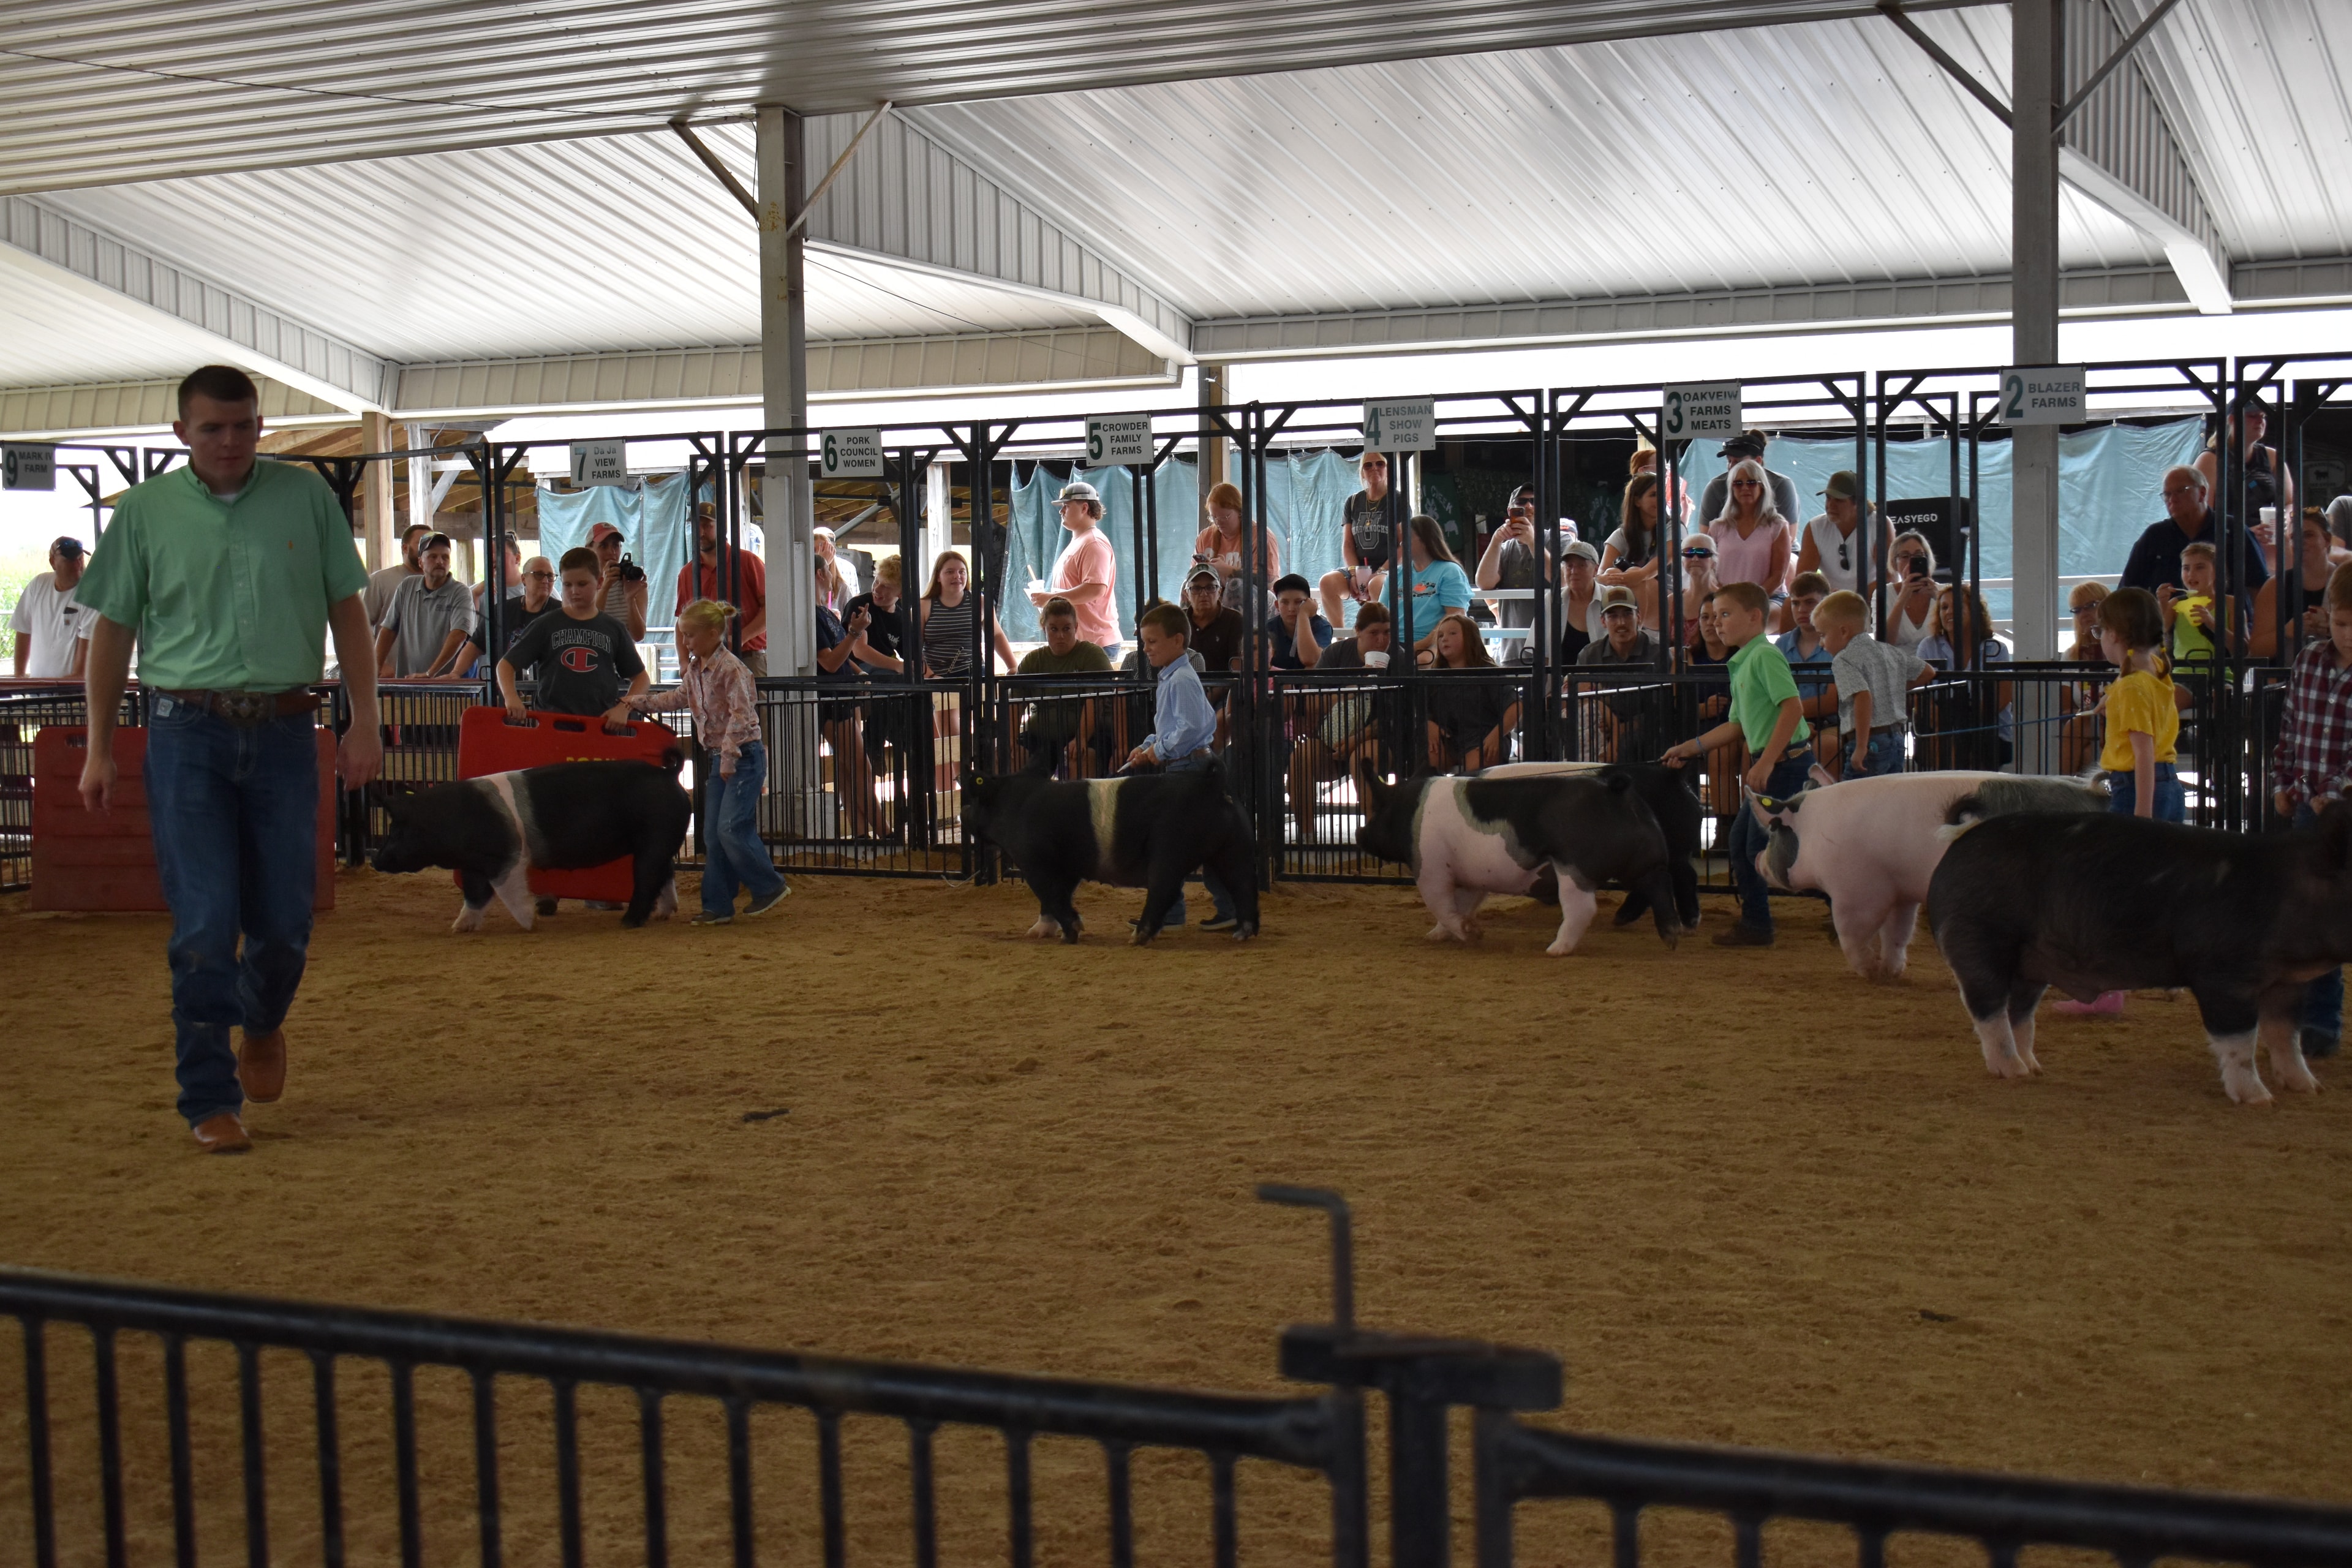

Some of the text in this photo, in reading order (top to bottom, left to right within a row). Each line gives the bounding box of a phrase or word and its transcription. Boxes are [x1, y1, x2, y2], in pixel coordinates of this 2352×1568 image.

[2028, 382, 2080, 393] BLAZER
[1683, 391, 1738, 402] OAKVEIW
[2005, 375, 2023, 418] 2
[2032, 397, 2077, 408] FARMS
[1379, 405, 1431, 417] LENSMAN
[1667, 391, 1683, 434] 3
[1691, 405, 1731, 416] FARMS
[1102, 421, 1148, 432] CROWDER
[1366, 407, 1381, 446] 4
[1389, 420, 1422, 430] SHOW
[1691, 419, 1731, 430] MEATS
[1089, 423, 1102, 460] 5
[1110, 434, 1141, 443] FAMILY
[1393, 433, 1419, 443] PIGS
[19, 451, 43, 461] MARK
[594, 446, 616, 455] Da Ja
[824, 435, 837, 472] 6
[840, 448, 878, 456] COUNCIL
[1112, 446, 1142, 455] FARMS
[575, 447, 586, 481] 7
[595, 458, 616, 467] VIEW
[6, 450, 18, 487] 9
[24, 464, 48, 473] FARM
[592, 470, 620, 479] FARMS
[1890, 513, 1937, 524] EASYEGO
[552, 628, 611, 654] CHAMPION
